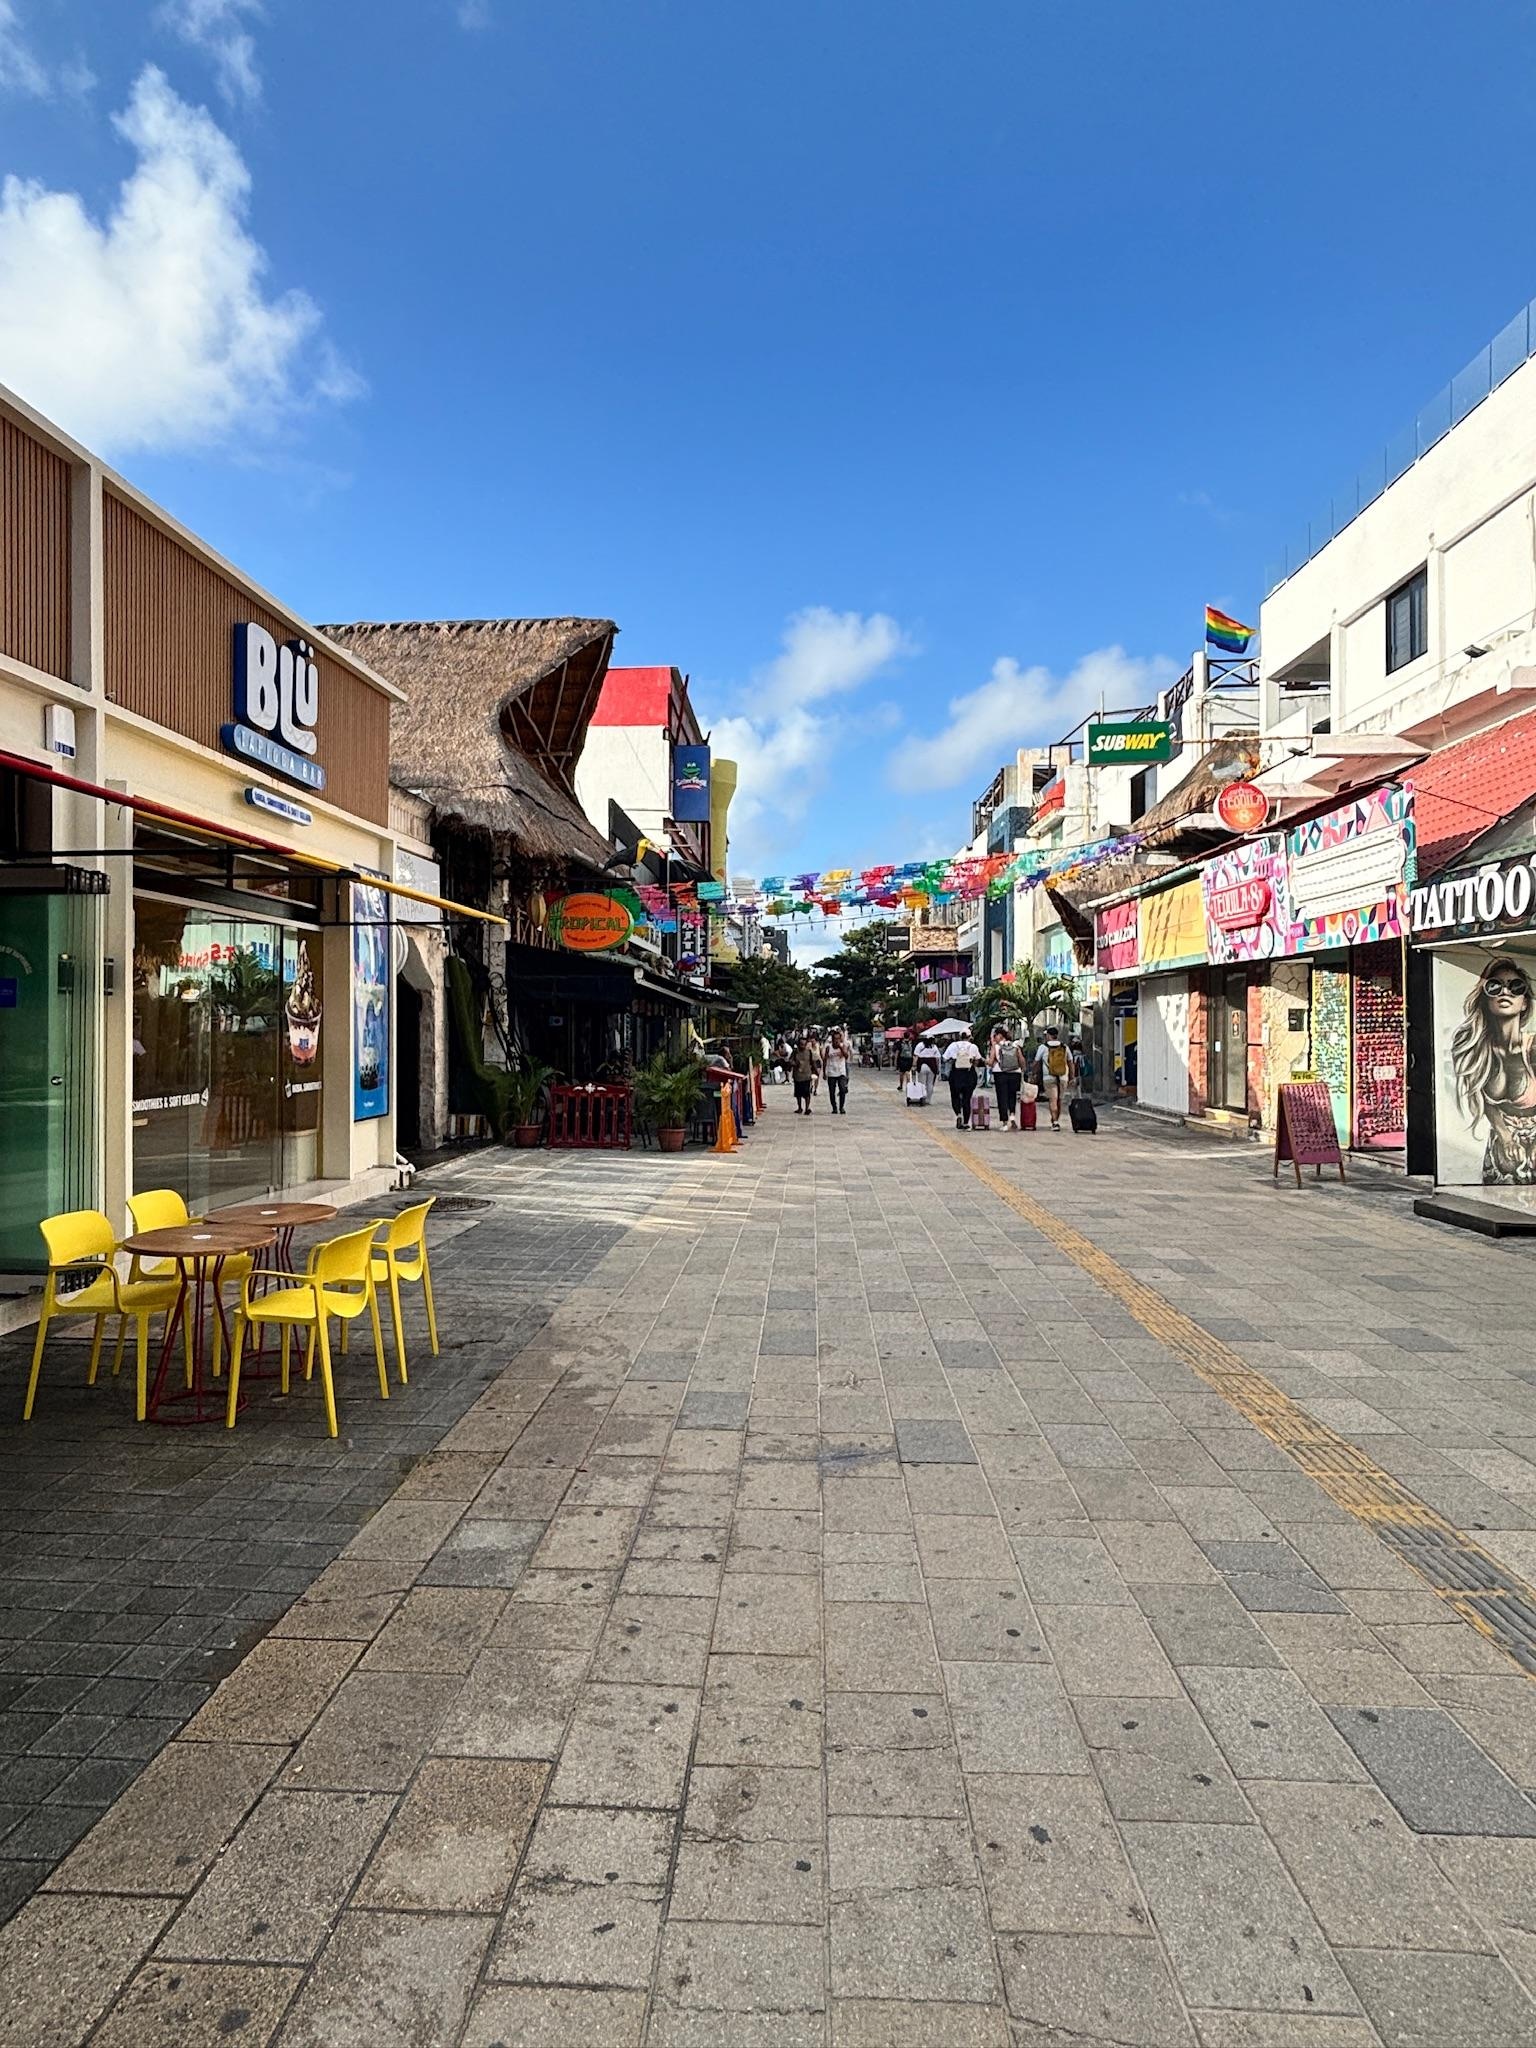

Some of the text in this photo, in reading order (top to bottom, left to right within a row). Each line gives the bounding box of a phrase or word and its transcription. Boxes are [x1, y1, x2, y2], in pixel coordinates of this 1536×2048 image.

[1091, 732, 1166, 752] SUBWAY
[240, 730, 323, 787] TAPIOCA BAR
[1220, 793, 1264, 809] TEQUILA
[1212, 886, 1249, 918] TEQUILA
[549, 915, 628, 932] TROPICAL
[133, 1097, 163, 1112] SMOOTHIES
[164, 1096, 169, 1109] &
[169, 1095, 182, 1108] SOFT
